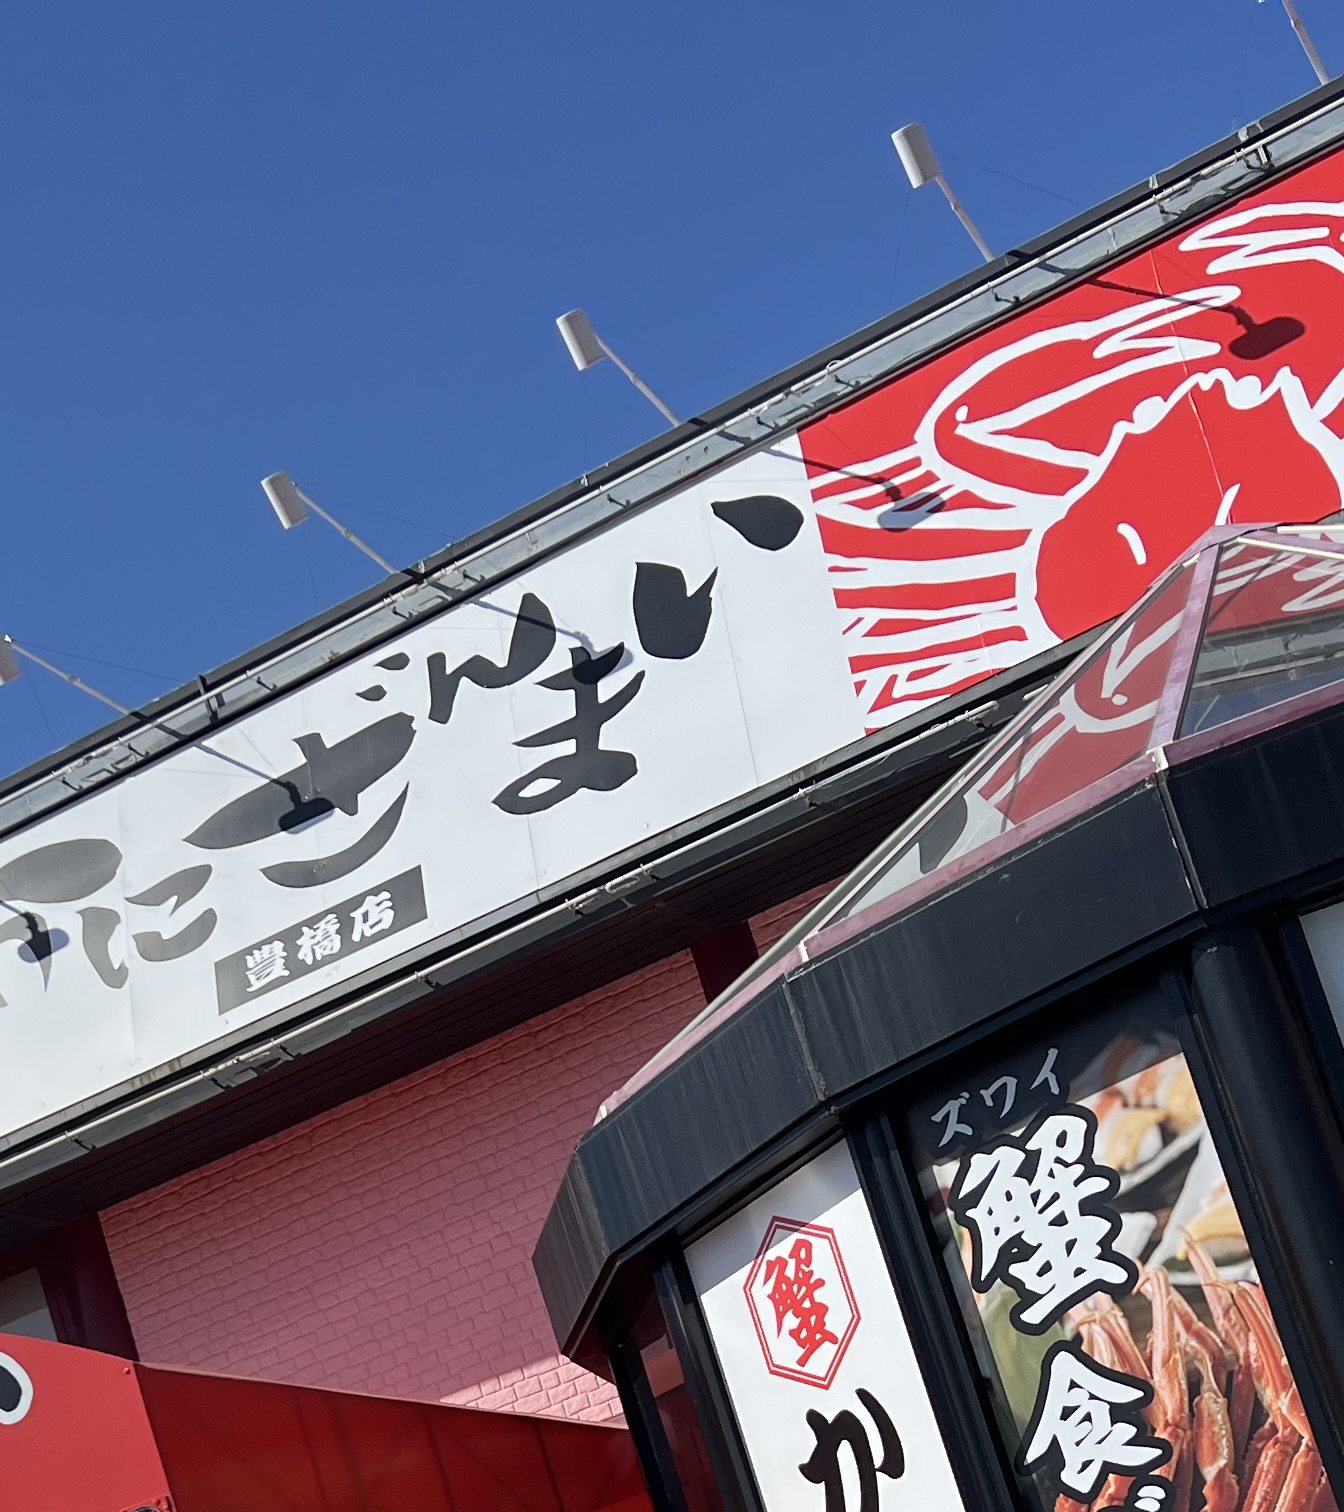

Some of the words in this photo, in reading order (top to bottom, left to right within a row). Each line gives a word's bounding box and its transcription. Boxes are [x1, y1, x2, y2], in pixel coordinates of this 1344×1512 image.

[245, 890, 394, 993] 豊橋店
[931, 1047, 1060, 1147] ズワイ
[763, 1238, 839, 1367] 蟹
